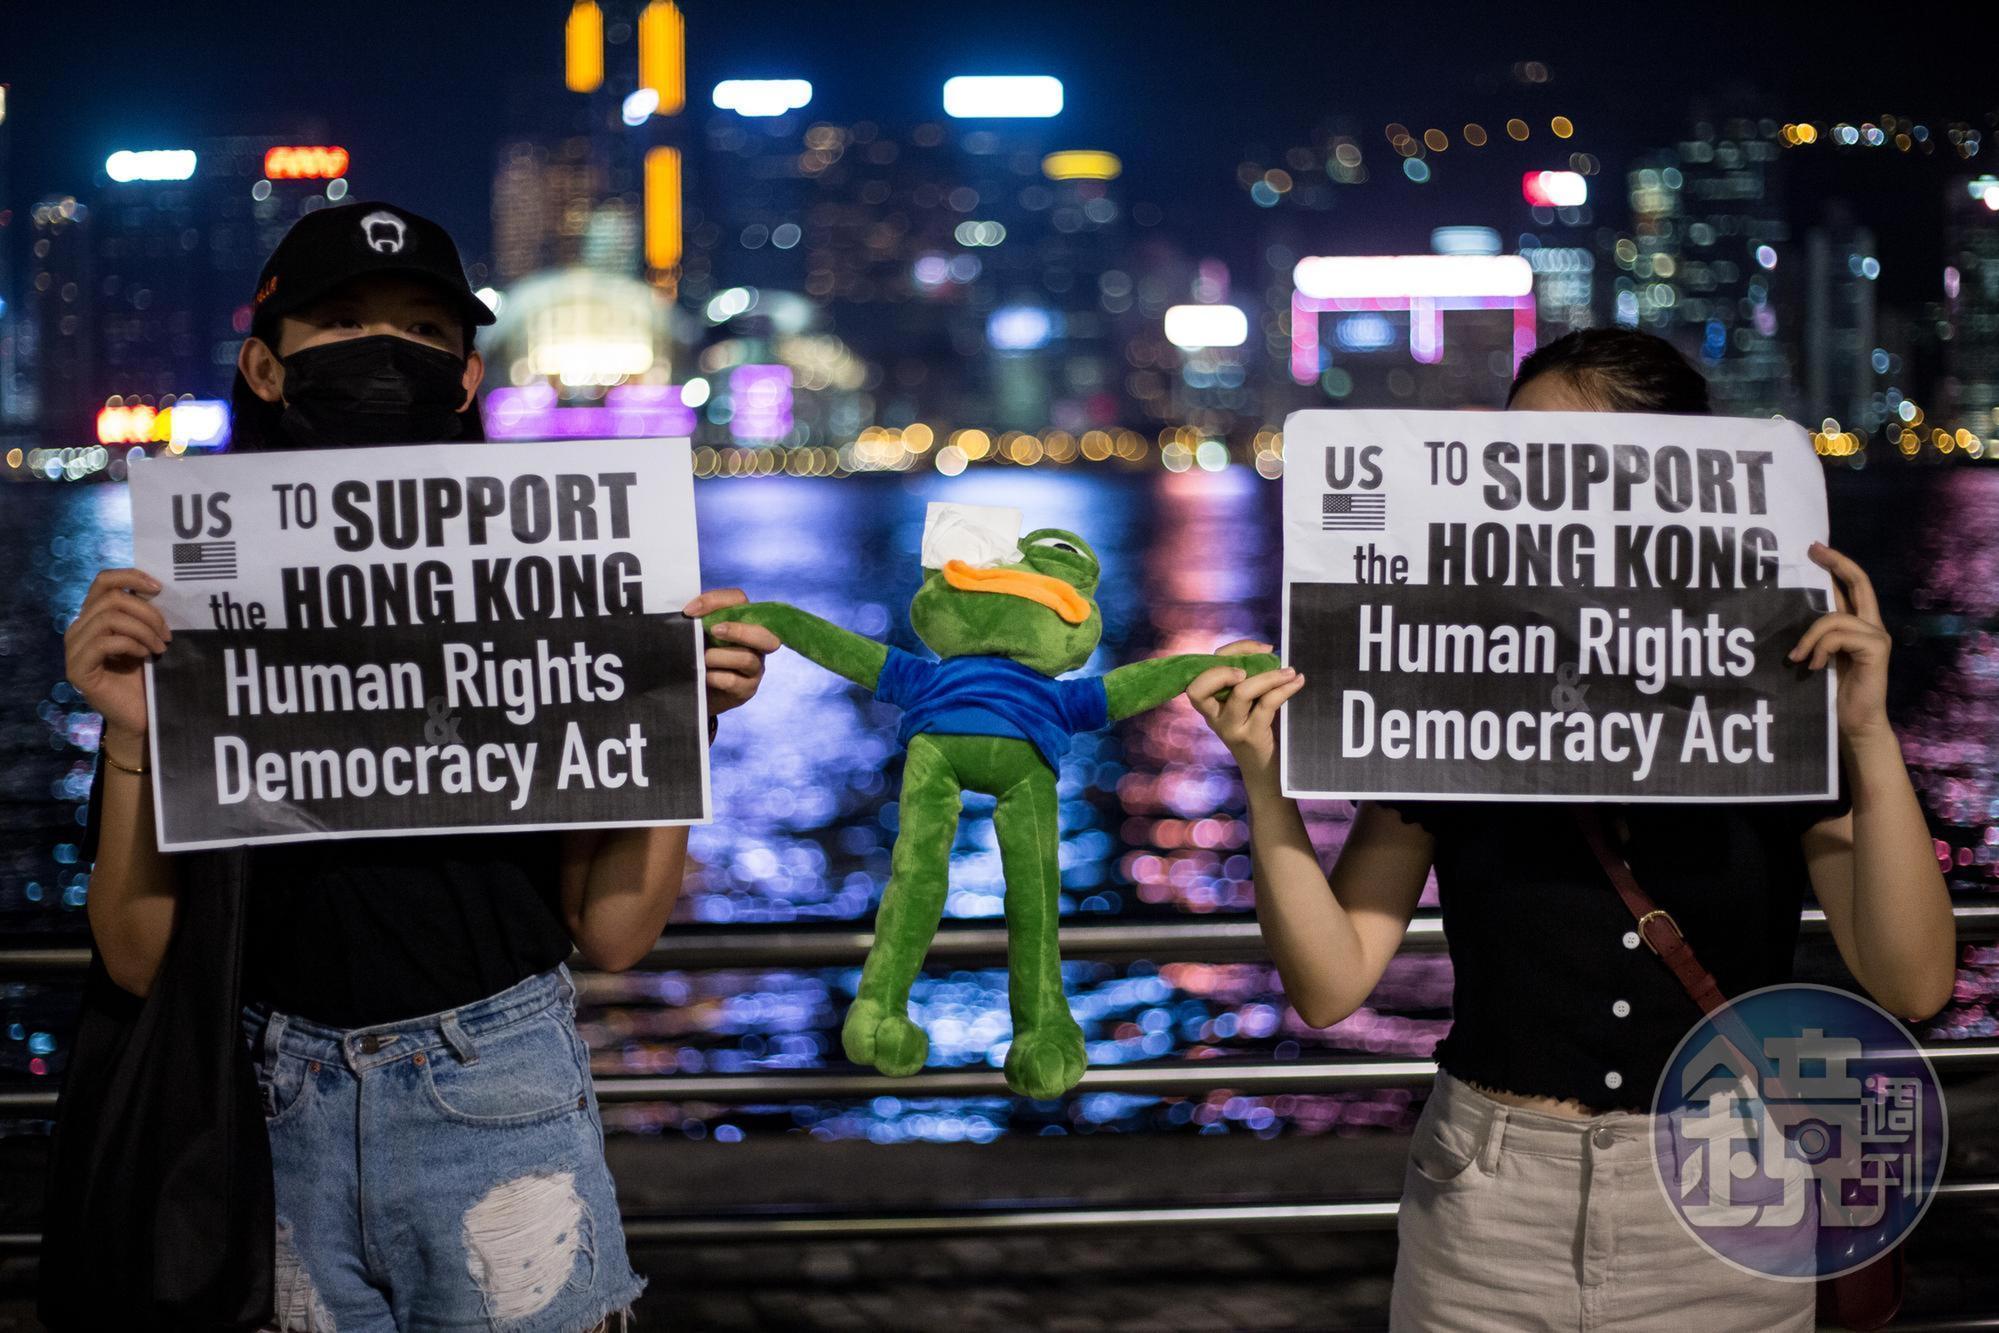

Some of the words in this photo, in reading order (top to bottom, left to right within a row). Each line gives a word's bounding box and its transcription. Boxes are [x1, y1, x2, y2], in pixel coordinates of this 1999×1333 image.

[172, 491, 232, 539] US
[272, 482, 317, 530] TO
[332, 472, 637, 552] SUPPORT
[1325, 445, 1384, 490] US
[1424, 441, 1467, 486] TO
[1482, 442, 1773, 515] SUPPORT
[209, 592, 267, 630] the
[281, 561, 455, 628] HONG
[472, 552, 643, 621] KONG
[1353, 544, 1409, 584] the
[1428, 523, 1595, 586] HONG
[1614, 524, 1778, 589] KONG
[223, 649, 424, 716] Human
[442, 640, 625, 725] Rights
[1359, 605, 1555, 673] Human
[1579, 608, 1755, 694] Rights
[1551, 662, 1588, 711] &
[424, 696, 463, 744] &
[1342, 690, 1664, 781] Democracy
[1680, 696, 1774, 764] Act
[213, 735, 537, 810] Democracy
[557, 721, 649, 790] Act
